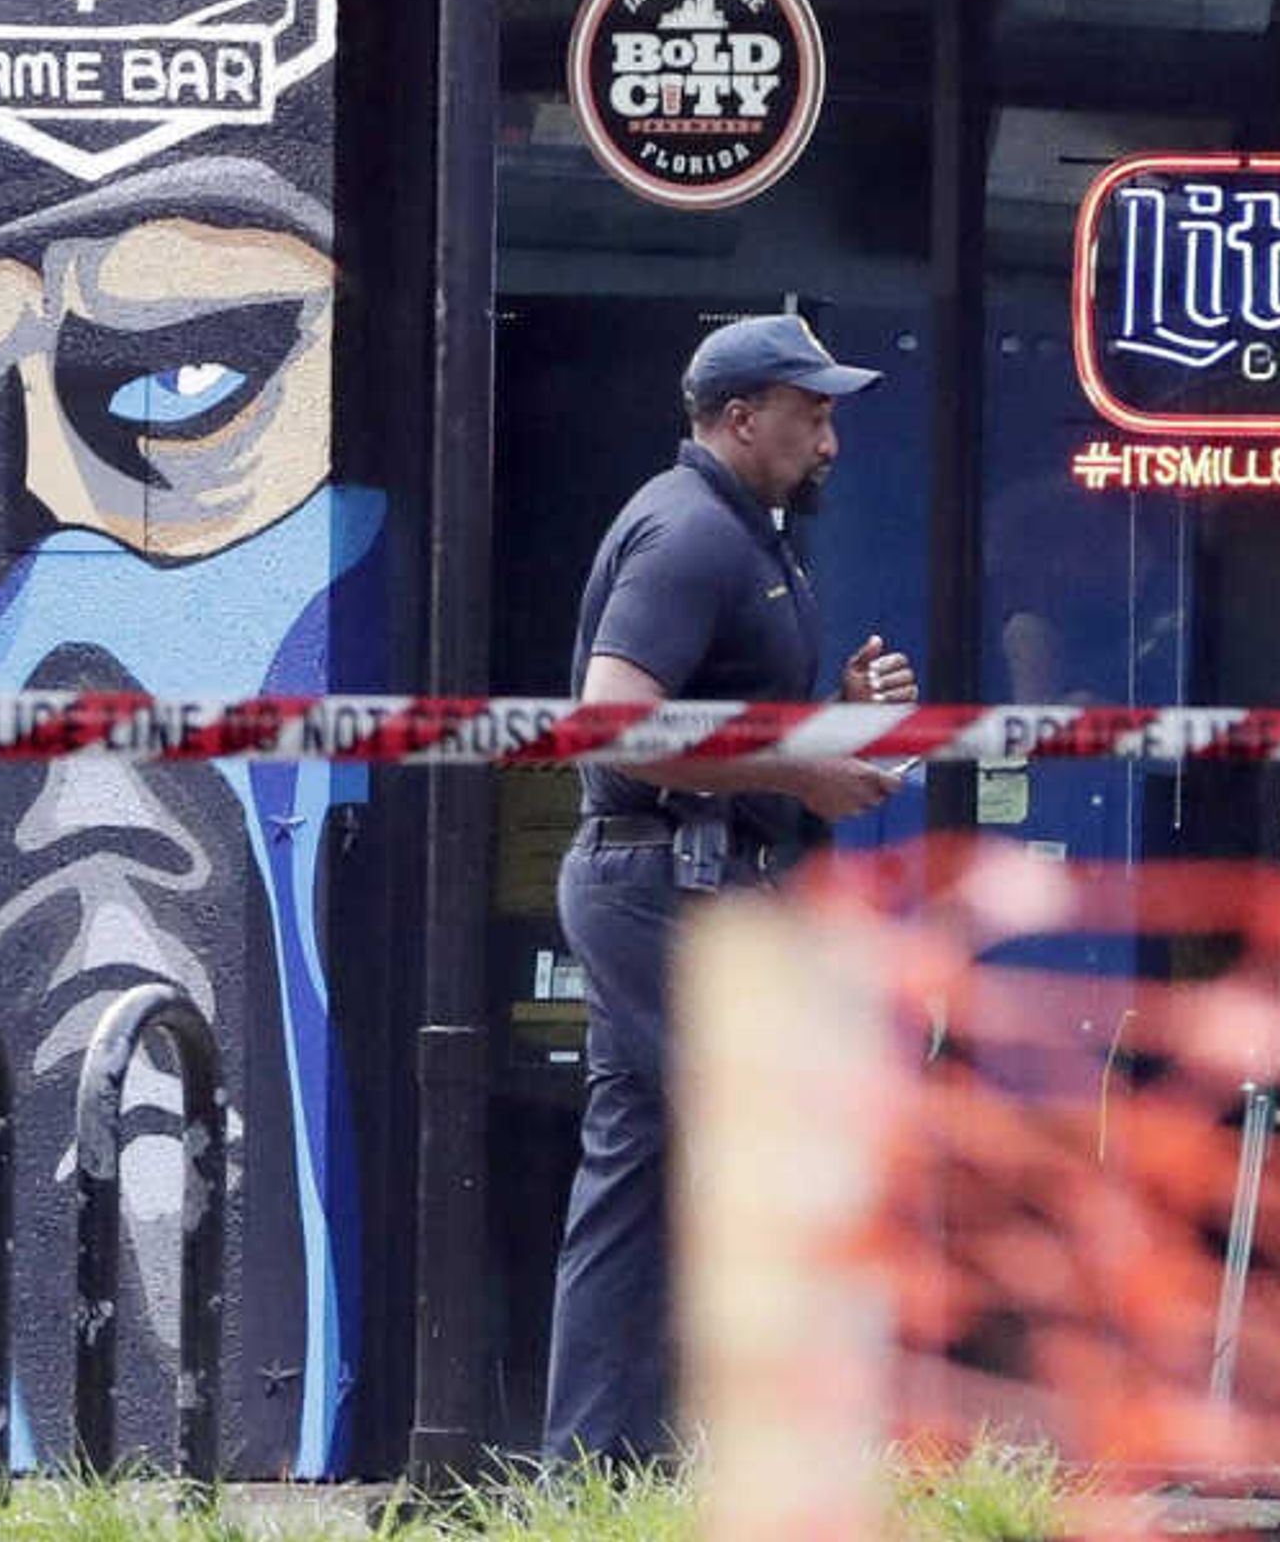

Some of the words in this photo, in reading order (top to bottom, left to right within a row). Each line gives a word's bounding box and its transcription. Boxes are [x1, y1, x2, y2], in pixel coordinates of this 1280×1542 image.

[122, 49, 255, 103] BAR
[609, 73, 780, 118] CITY
[639, 142, 752, 178] FLORIDA
[106, 702, 204, 752] LINE
[302, 707, 381, 755] NOT
[402, 707, 559, 757] CROSS
